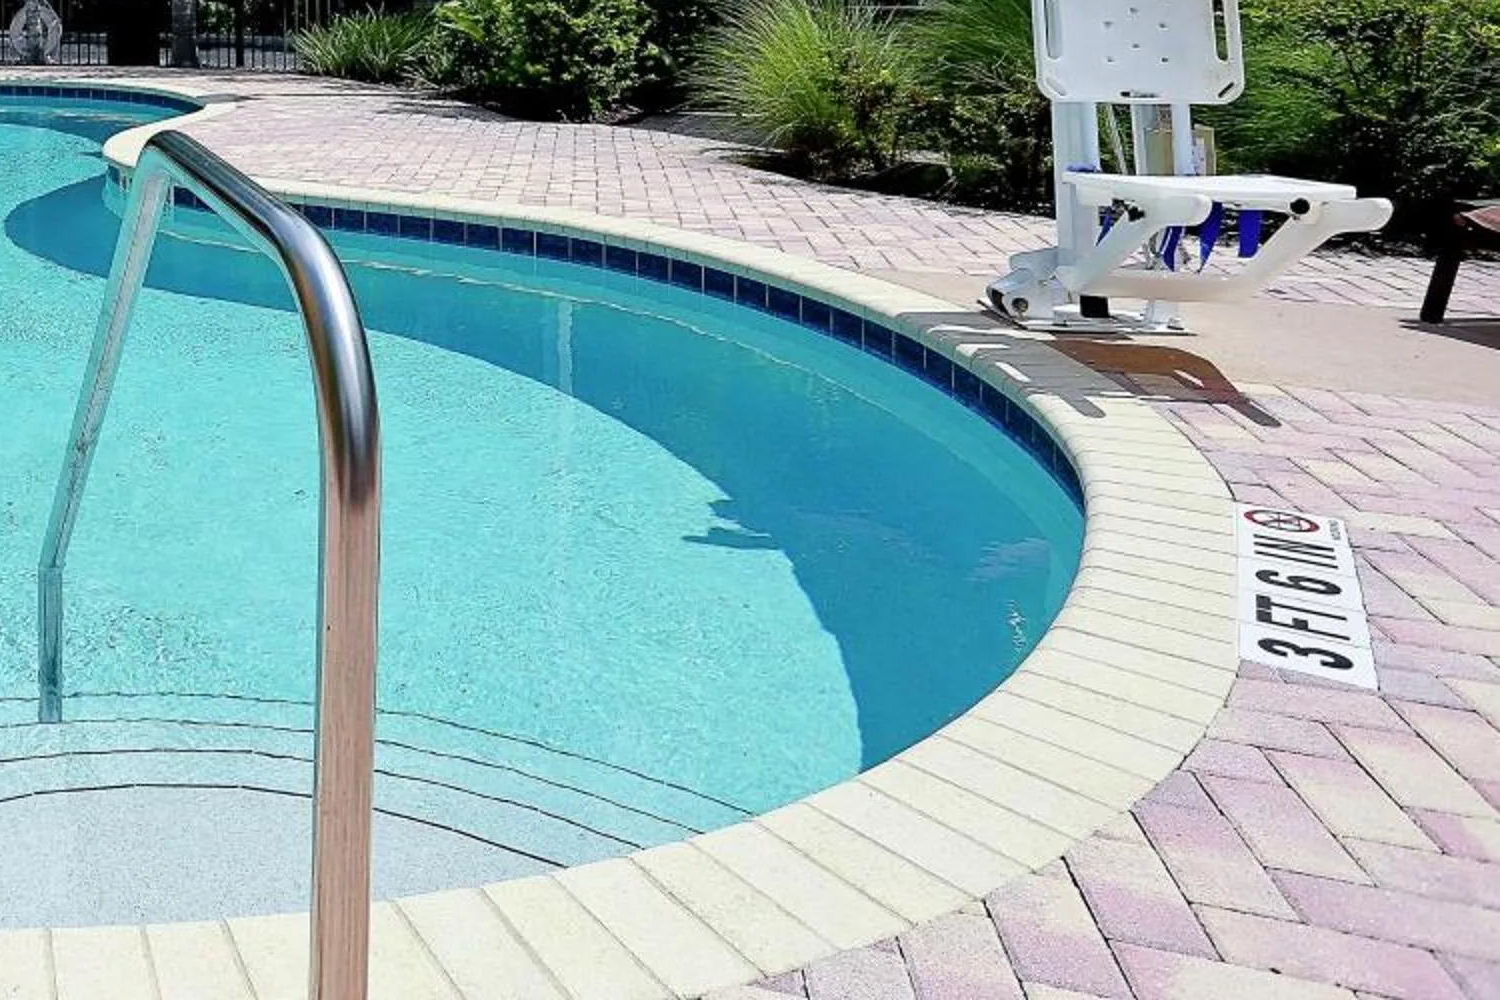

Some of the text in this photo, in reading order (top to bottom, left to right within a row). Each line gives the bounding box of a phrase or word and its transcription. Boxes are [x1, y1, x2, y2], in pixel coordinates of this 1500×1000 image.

[1253, 534, 1353, 669] 3 FT 6 IN
